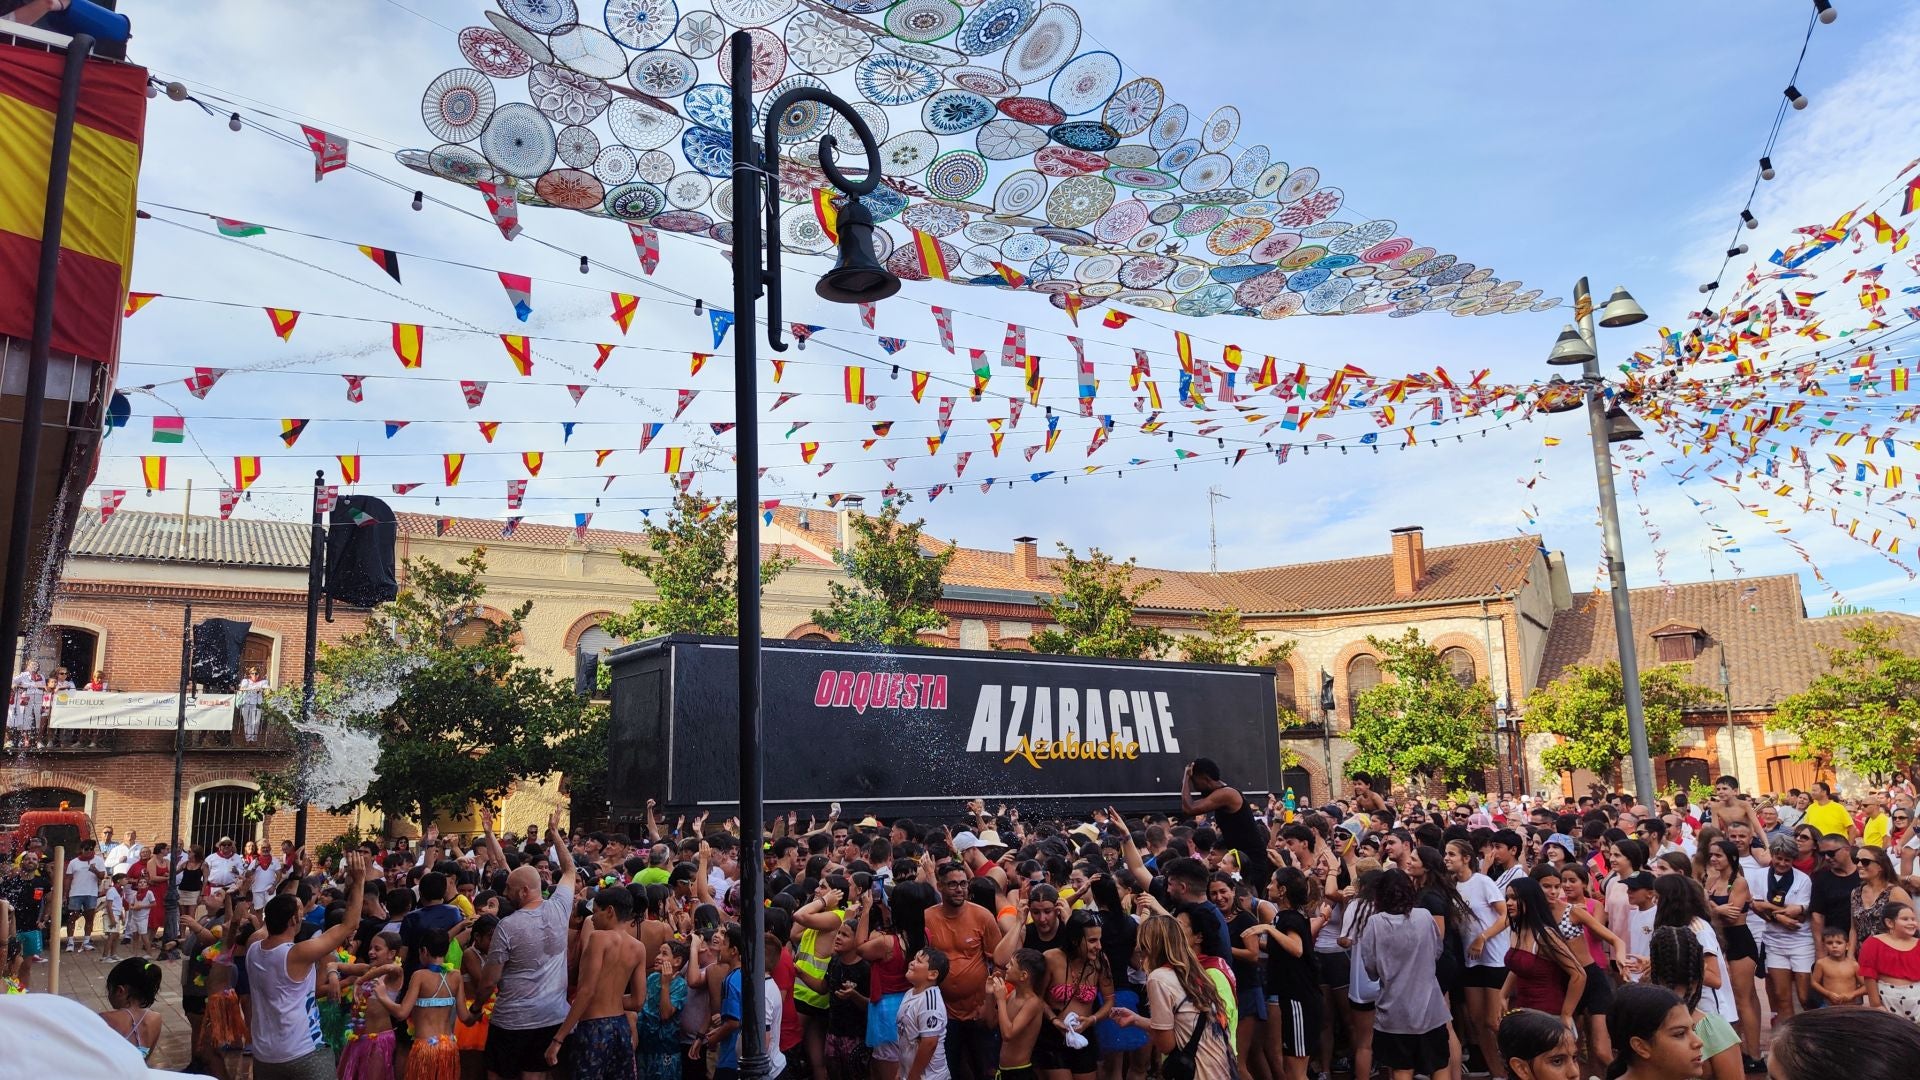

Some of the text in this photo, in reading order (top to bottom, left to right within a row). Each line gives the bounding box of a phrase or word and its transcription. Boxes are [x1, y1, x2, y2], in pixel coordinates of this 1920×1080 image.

[68, 698, 105, 706] HEDILUX
[814, 670, 948, 715] ORQUESTA
[966, 684, 1181, 754] AZABACHE
[1003, 731, 1140, 769] Azabache
